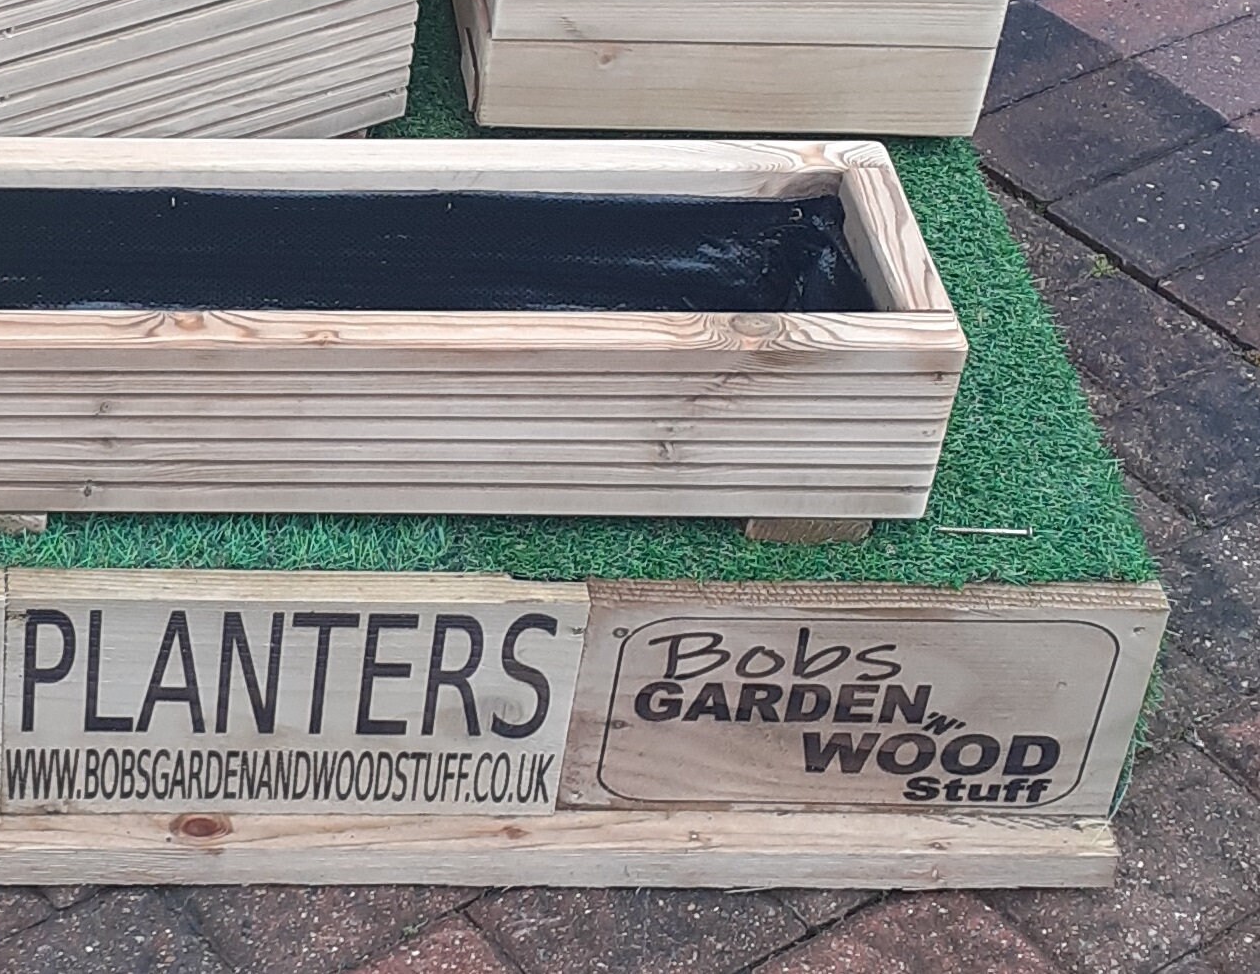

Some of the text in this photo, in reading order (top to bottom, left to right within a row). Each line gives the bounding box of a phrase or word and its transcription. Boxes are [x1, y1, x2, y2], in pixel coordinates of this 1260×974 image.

[21, 609, 557, 738] PLANTERS
[648, 627, 903, 681] Bobs
[633, 682, 933, 724] GARDEN
[5, 747, 555, 804] WWW.BOBSGARDENANDWOODSTUFF.CO.UK
[802, 731, 1061, 776] WOOD
[903, 777, 1052, 803] Stuff
